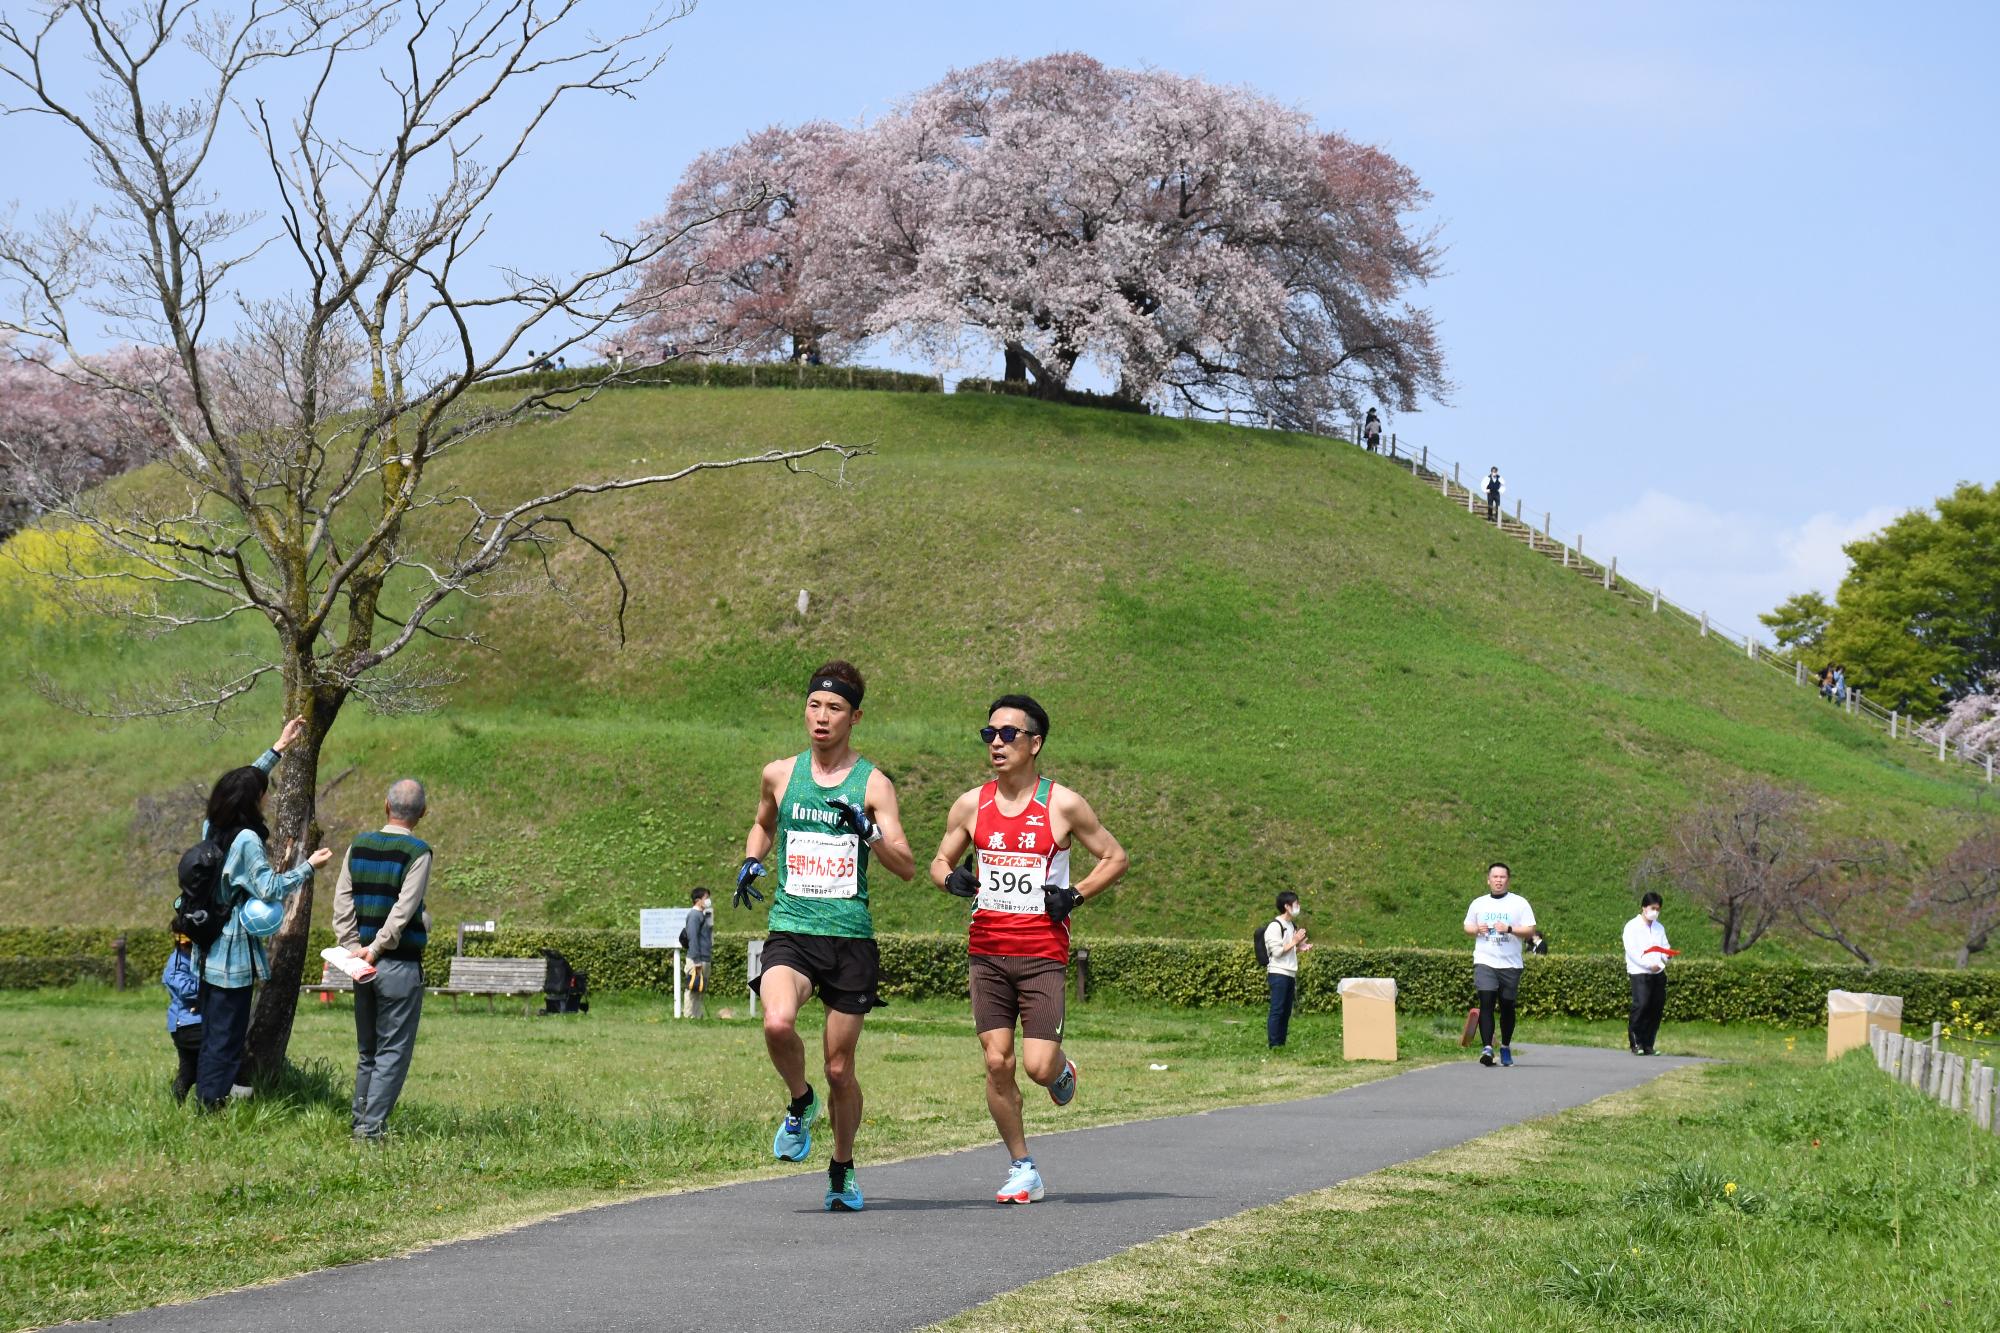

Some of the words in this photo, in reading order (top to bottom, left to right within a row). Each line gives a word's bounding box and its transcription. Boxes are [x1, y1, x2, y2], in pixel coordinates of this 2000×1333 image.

[792, 802, 849, 826] KOTOBUKI
[988, 831, 1036, 849] 鹿沼
[788, 854, 854, 877] 宇野けんたろう
[989, 871, 1032, 895] 596
[1484, 912, 1508, 921] 3044
